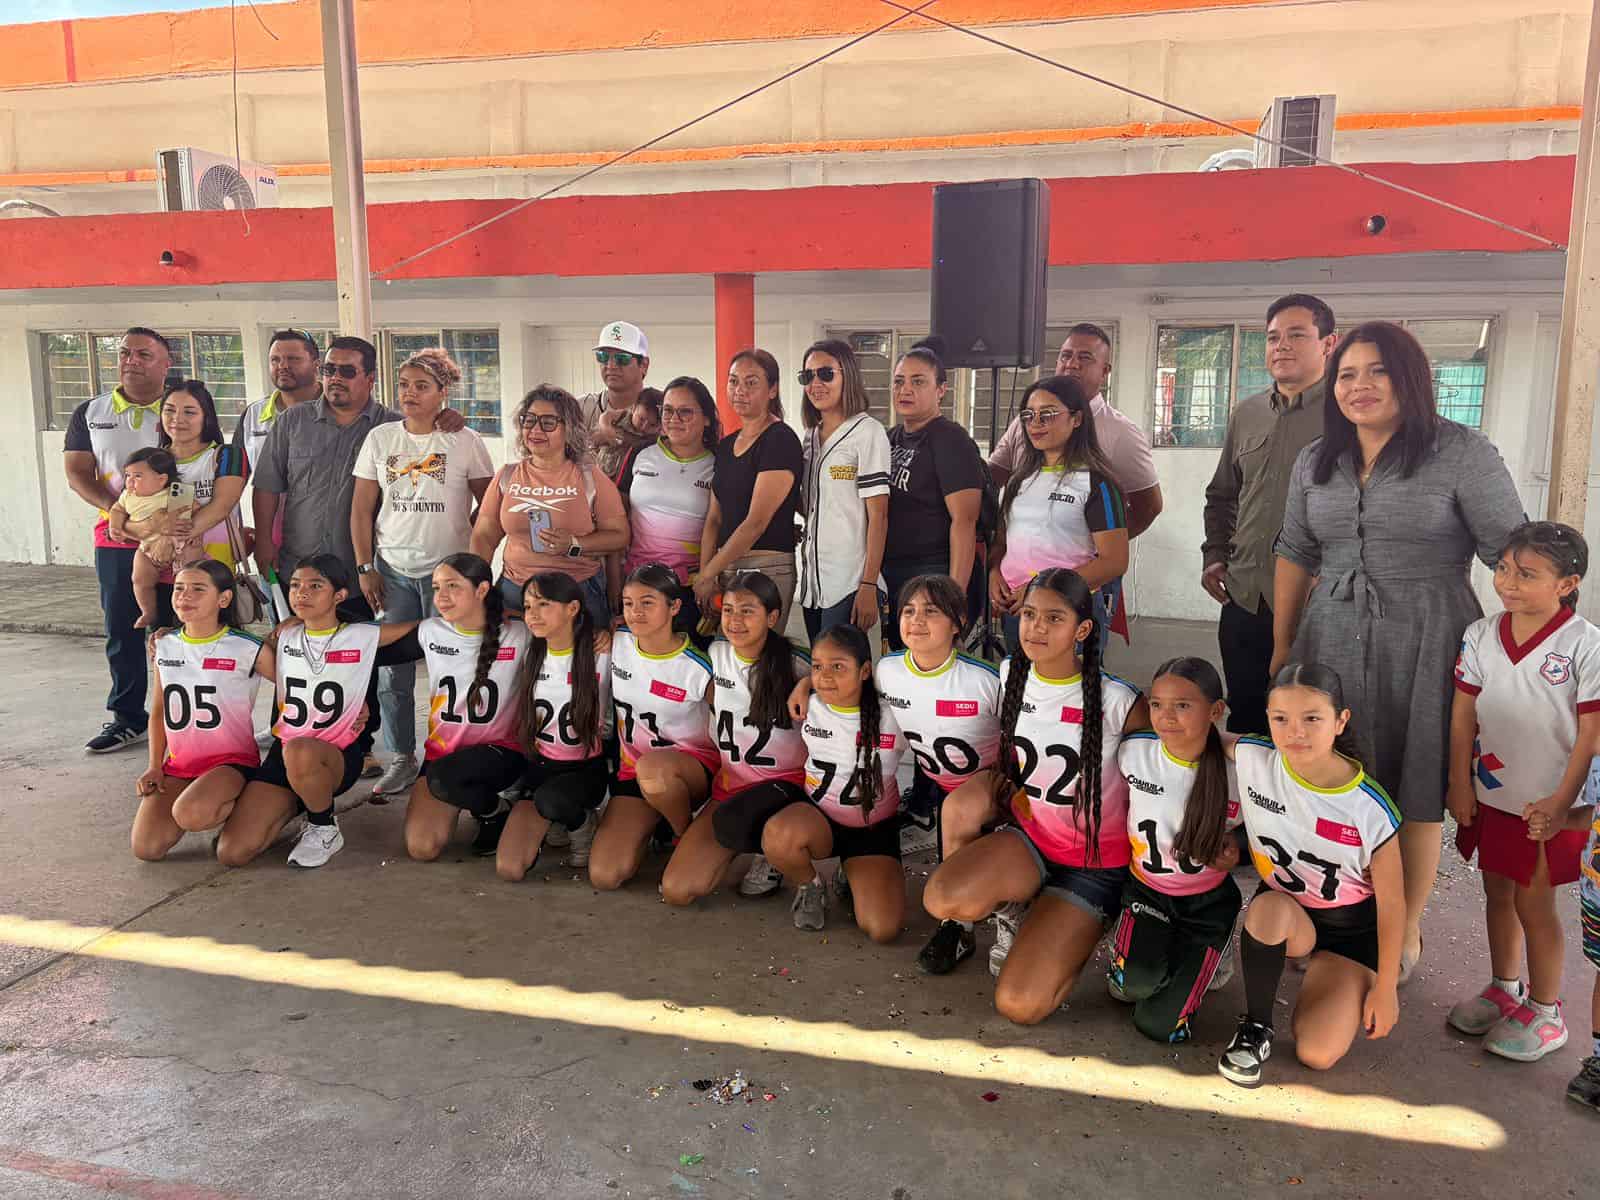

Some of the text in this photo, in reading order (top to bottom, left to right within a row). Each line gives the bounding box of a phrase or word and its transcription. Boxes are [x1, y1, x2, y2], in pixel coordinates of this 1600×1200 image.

[409, 502, 445, 512] COUNTRY
[509, 483, 578, 496] Reebok
[163, 684, 221, 730] 05
[282, 677, 344, 730] 59
[439, 676, 498, 723] 10
[536, 699, 582, 745] 26
[718, 710, 775, 765] 42
[811, 759, 875, 806] 74
[1013, 736, 1081, 805] 22
[1127, 774, 1164, 792] COAHUILA
[1256, 836, 1341, 901] 37
